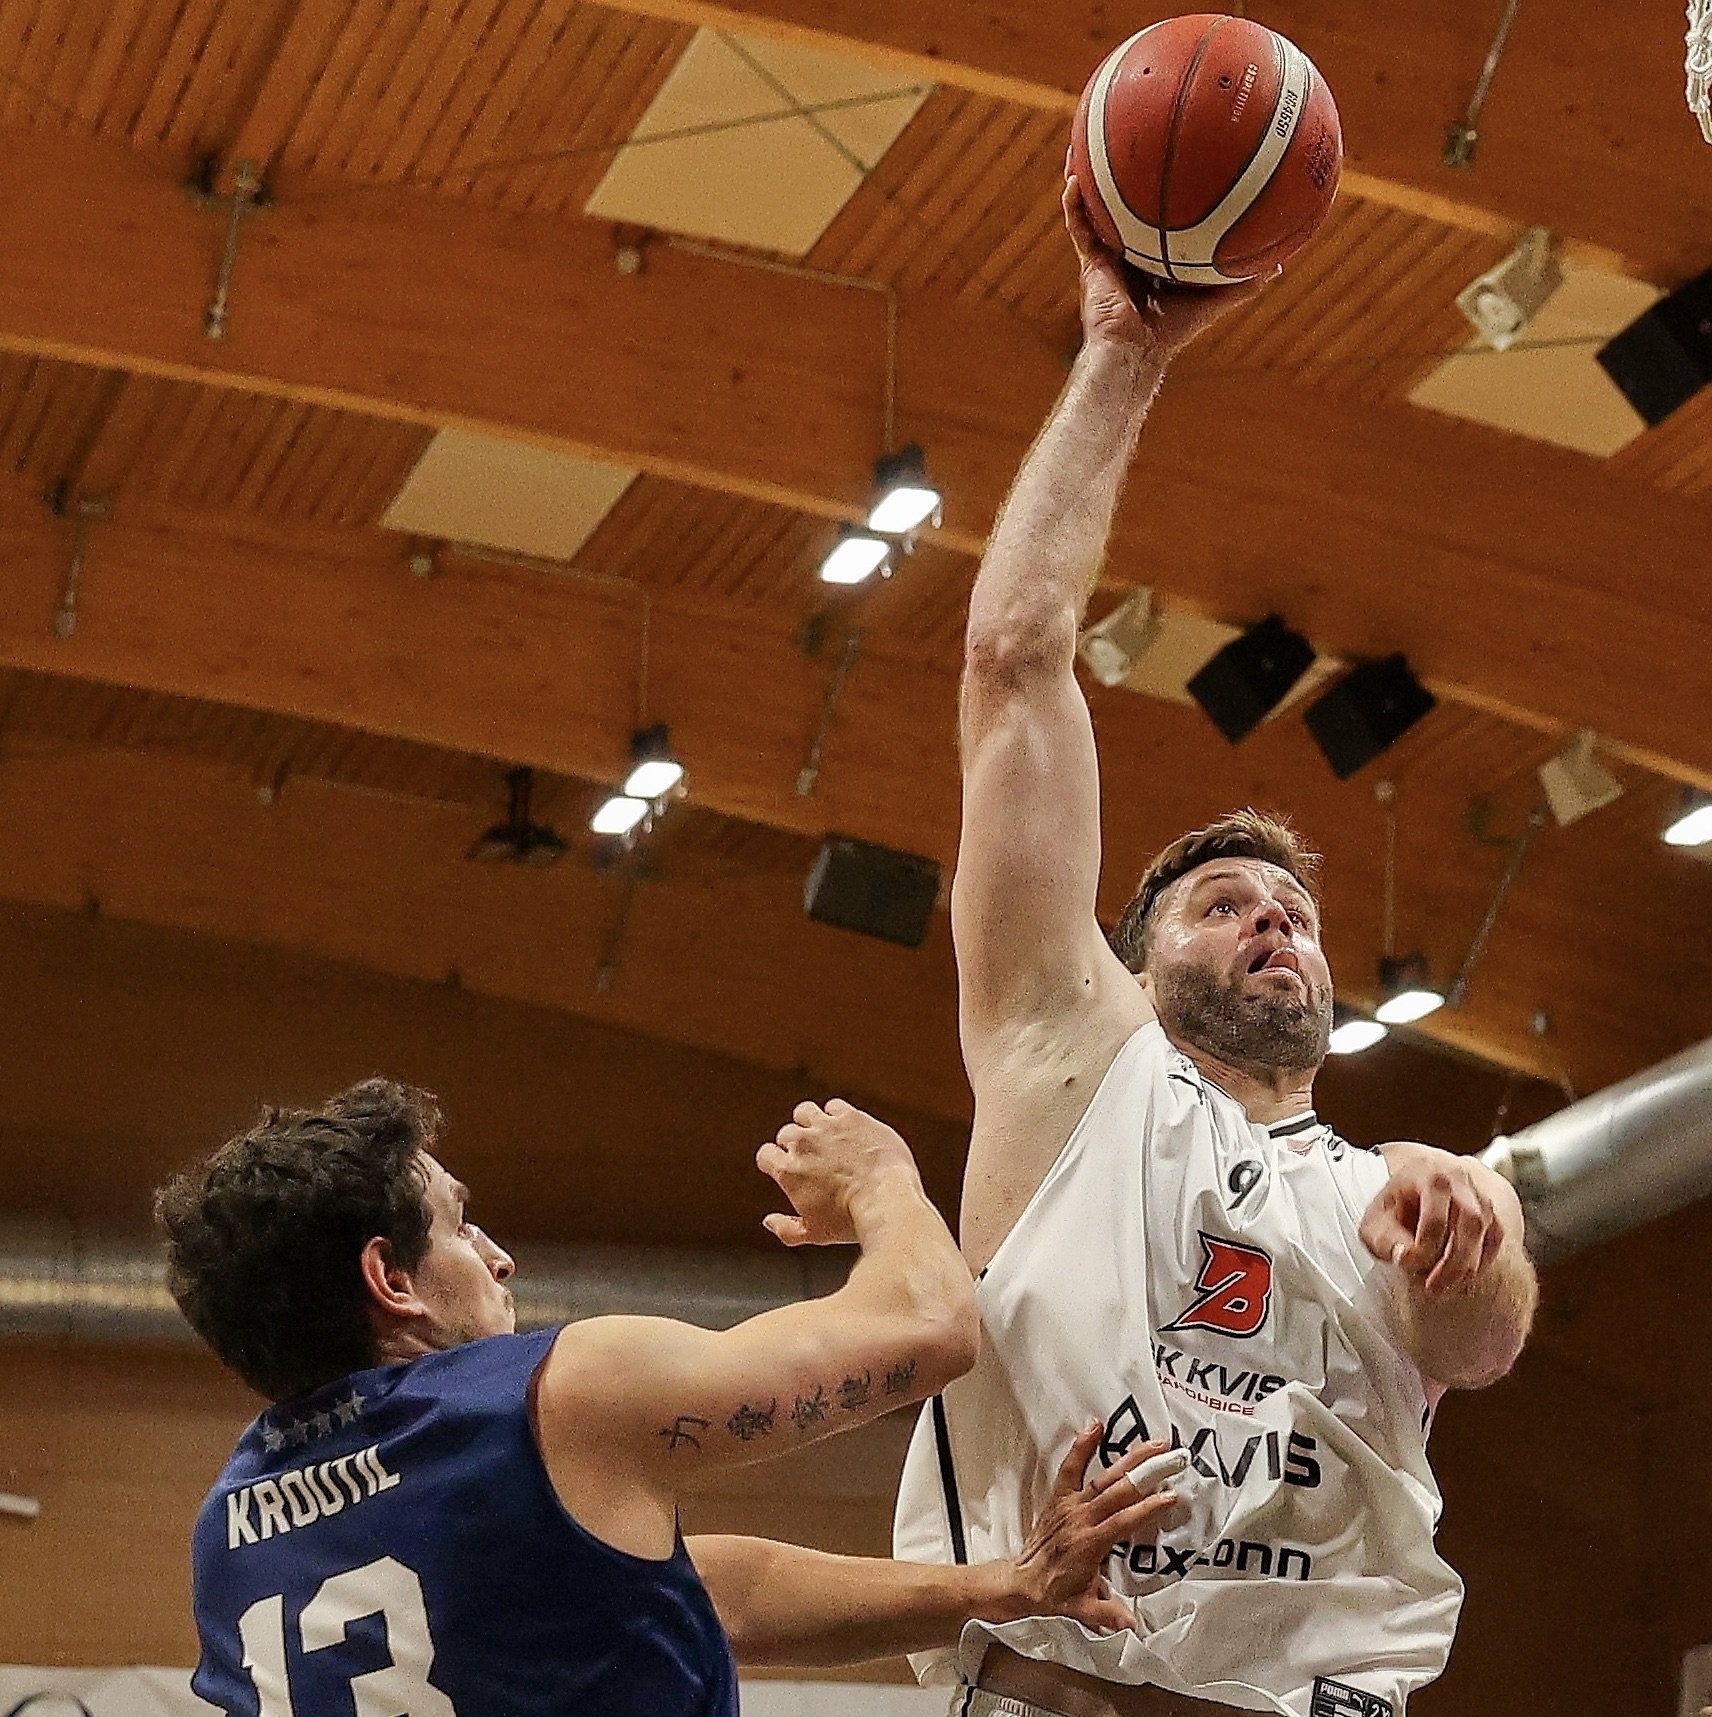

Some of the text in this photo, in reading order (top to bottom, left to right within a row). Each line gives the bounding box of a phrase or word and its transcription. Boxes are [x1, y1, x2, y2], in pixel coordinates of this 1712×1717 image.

[1150, 1336, 1287, 1403] K KVIS
[1156, 1371, 1255, 1416] ARDUBICE
[226, 1444, 401, 1549] KROUTIL
[237, 1555, 456, 1717] 13
[1320, 1682, 1350, 1700] PUMA
